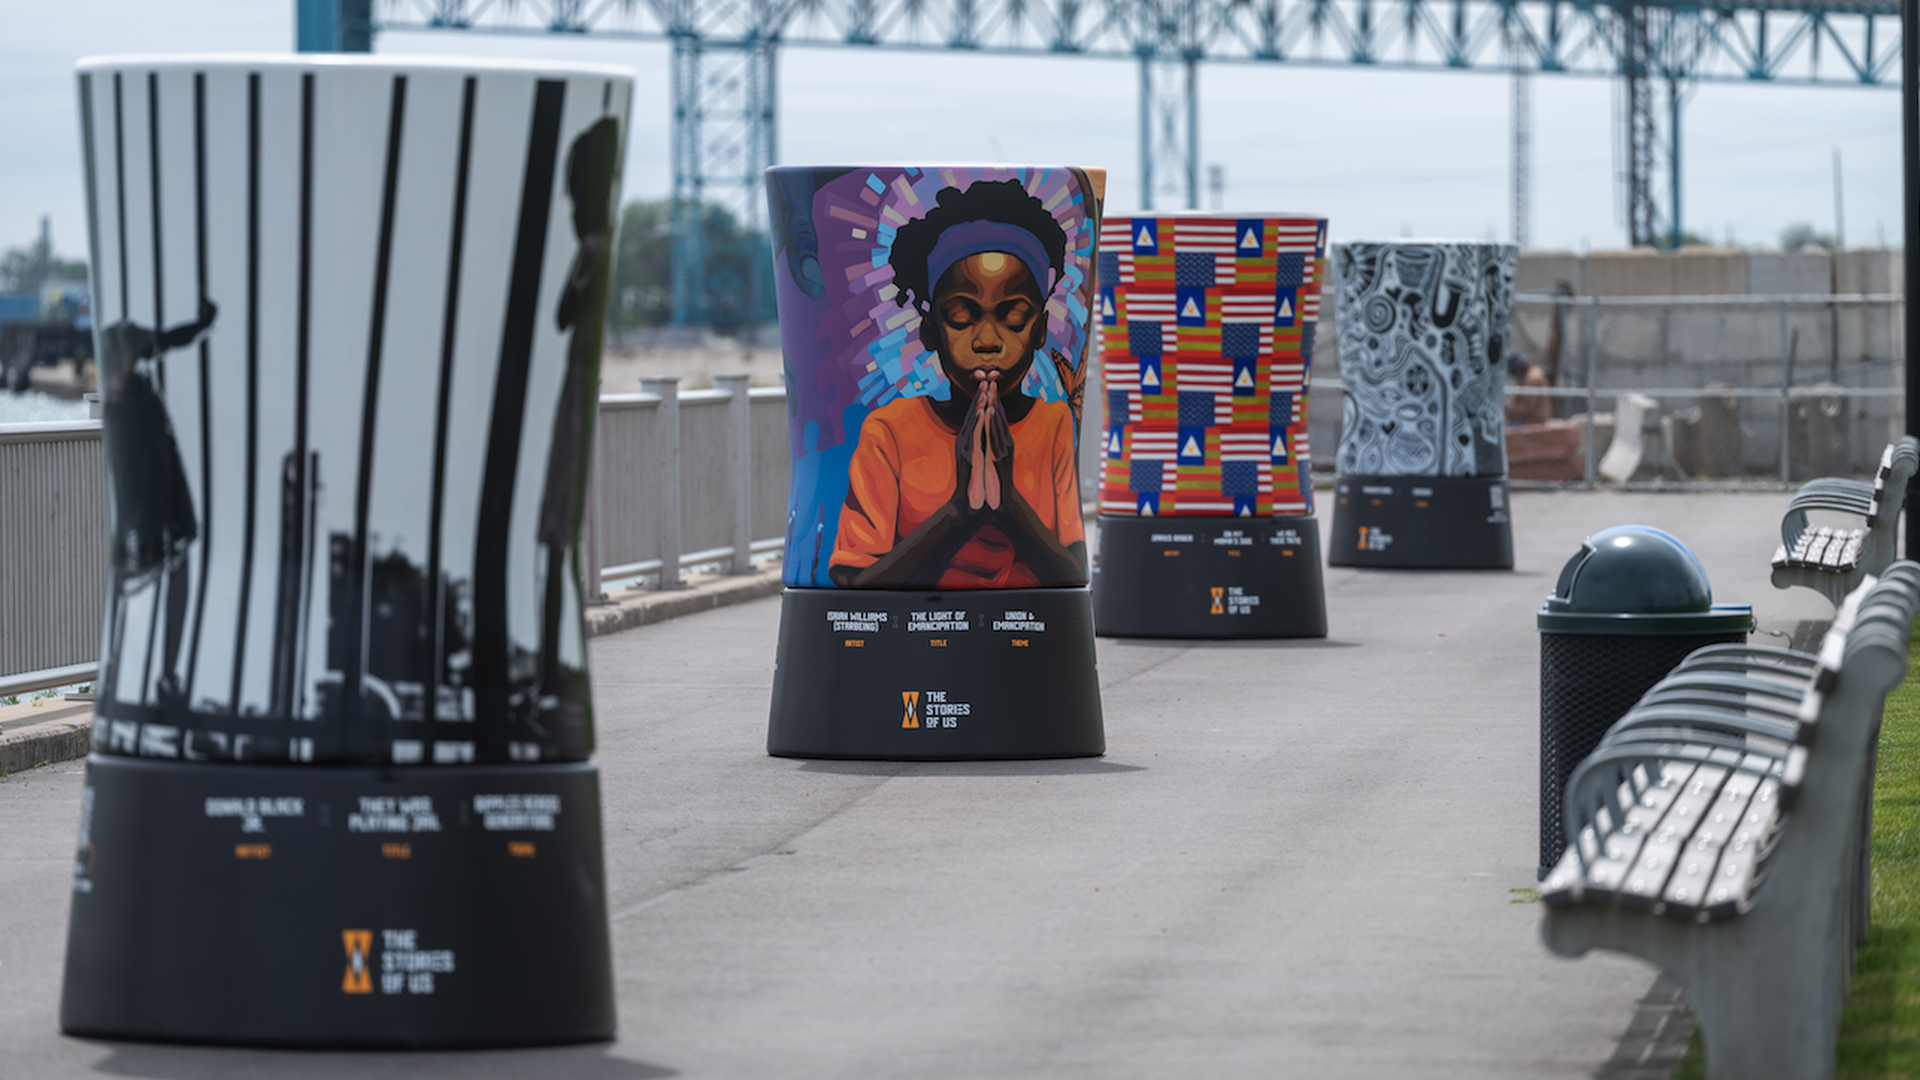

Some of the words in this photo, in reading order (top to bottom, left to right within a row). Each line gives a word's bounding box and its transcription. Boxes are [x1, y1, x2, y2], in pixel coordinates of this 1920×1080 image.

[826, 611, 848, 621] ISAIAH
[850, 611, 888, 622] WILLIAMS
[911, 611, 927, 621] THE
[929, 611, 953, 621] LIGHT
[955, 611, 966, 621] OF
[1005, 611, 1027, 621] UNION
[1029, 612, 1035, 620] &
[907, 621, 969, 631] EMANCIPATION
[993, 621, 1045, 631] EMANCIPATION
[844, 639, 865, 647] ARTIST
[930, 639, 948, 647] TITLE
[1011, 639, 1029, 647] THEME
[926, 691, 947, 702] THE
[926, 703, 971, 716] STORIES
[926, 717, 940, 729] OF
[942, 717, 958, 728] US
[381, 928, 418, 951] THE
[381, 949, 456, 973] STORIES
[381, 972, 406, 995] OF
[407, 972, 435, 995] US
